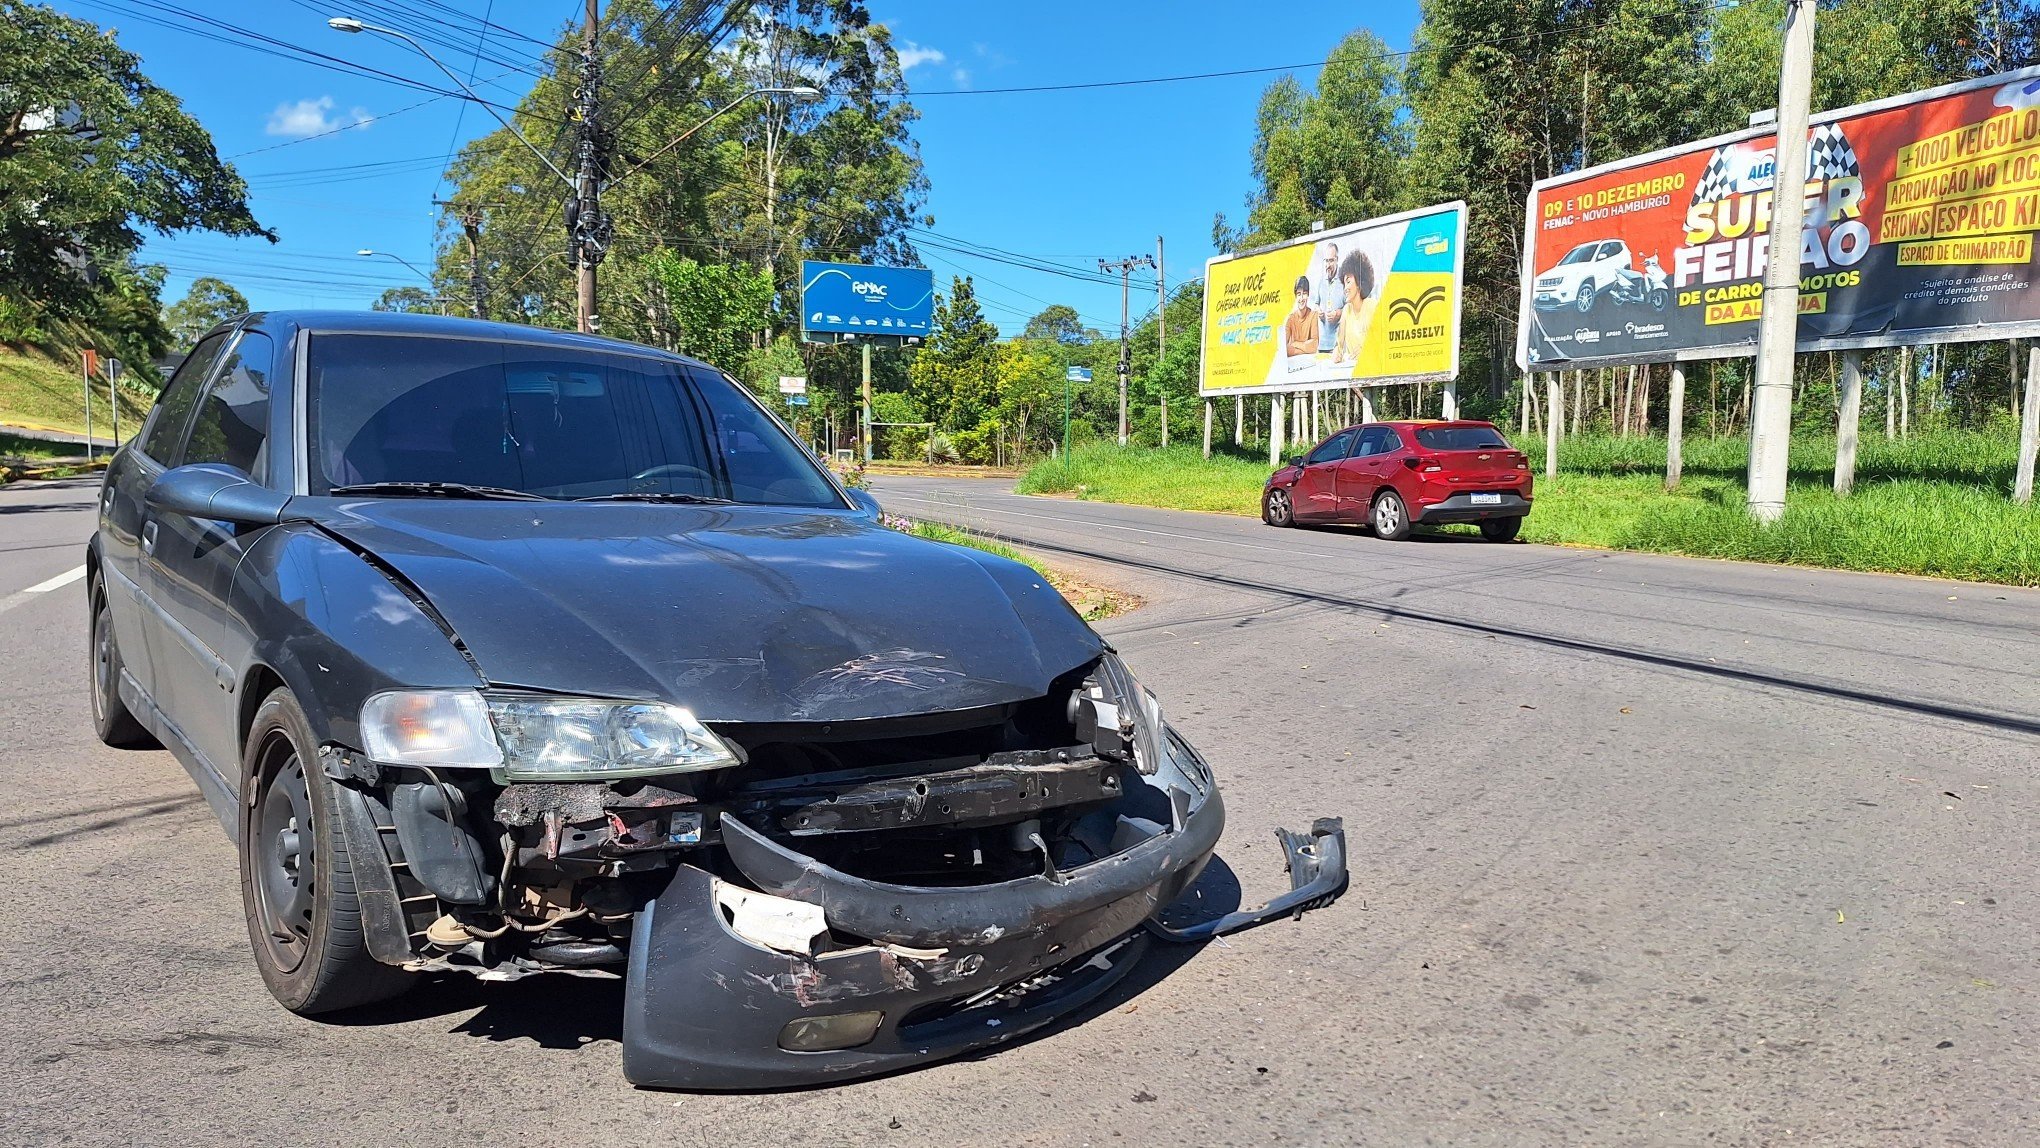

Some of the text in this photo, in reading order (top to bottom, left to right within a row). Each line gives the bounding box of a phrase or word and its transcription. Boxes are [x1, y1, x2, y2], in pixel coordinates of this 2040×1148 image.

[1902, 109, 2040, 168] +1000 VEÍCULO
[1891, 154, 2040, 206] APROVAÇÃO NO LOC
[1544, 172, 1685, 218] 09 E 10 DEZEMBRO
[1544, 216, 1574, 230] FENAC
[1582, 208, 1608, 222] NOVO
[1610, 194, 1670, 216] HAMBURGO
[1882, 194, 2040, 238] SHOWS ESPAÇO KI
[1900, 237, 2026, 264] ESPAÇO DE CHIMARRÃO
[1224, 266, 1266, 296] PARA VOCÊ
[1678, 290, 1701, 306] DE
[1798, 270, 1860, 290] MOTOS
[1904, 288, 1935, 299] crédito
[1944, 285, 1978, 295] demais
[1980, 281, 2029, 292] condições
[1964, 274, 2000, 284] análise
[2002, 272, 2014, 280] de
[1216, 298, 1240, 312] CHEGAR
[1241, 294, 1258, 308] MAIS
[1710, 306, 1735, 320] DA
[1938, 294, 1989, 306] do produto
[1388, 325, 1444, 342] UNIASSELVI
[1634, 324, 1664, 333] bradesco
